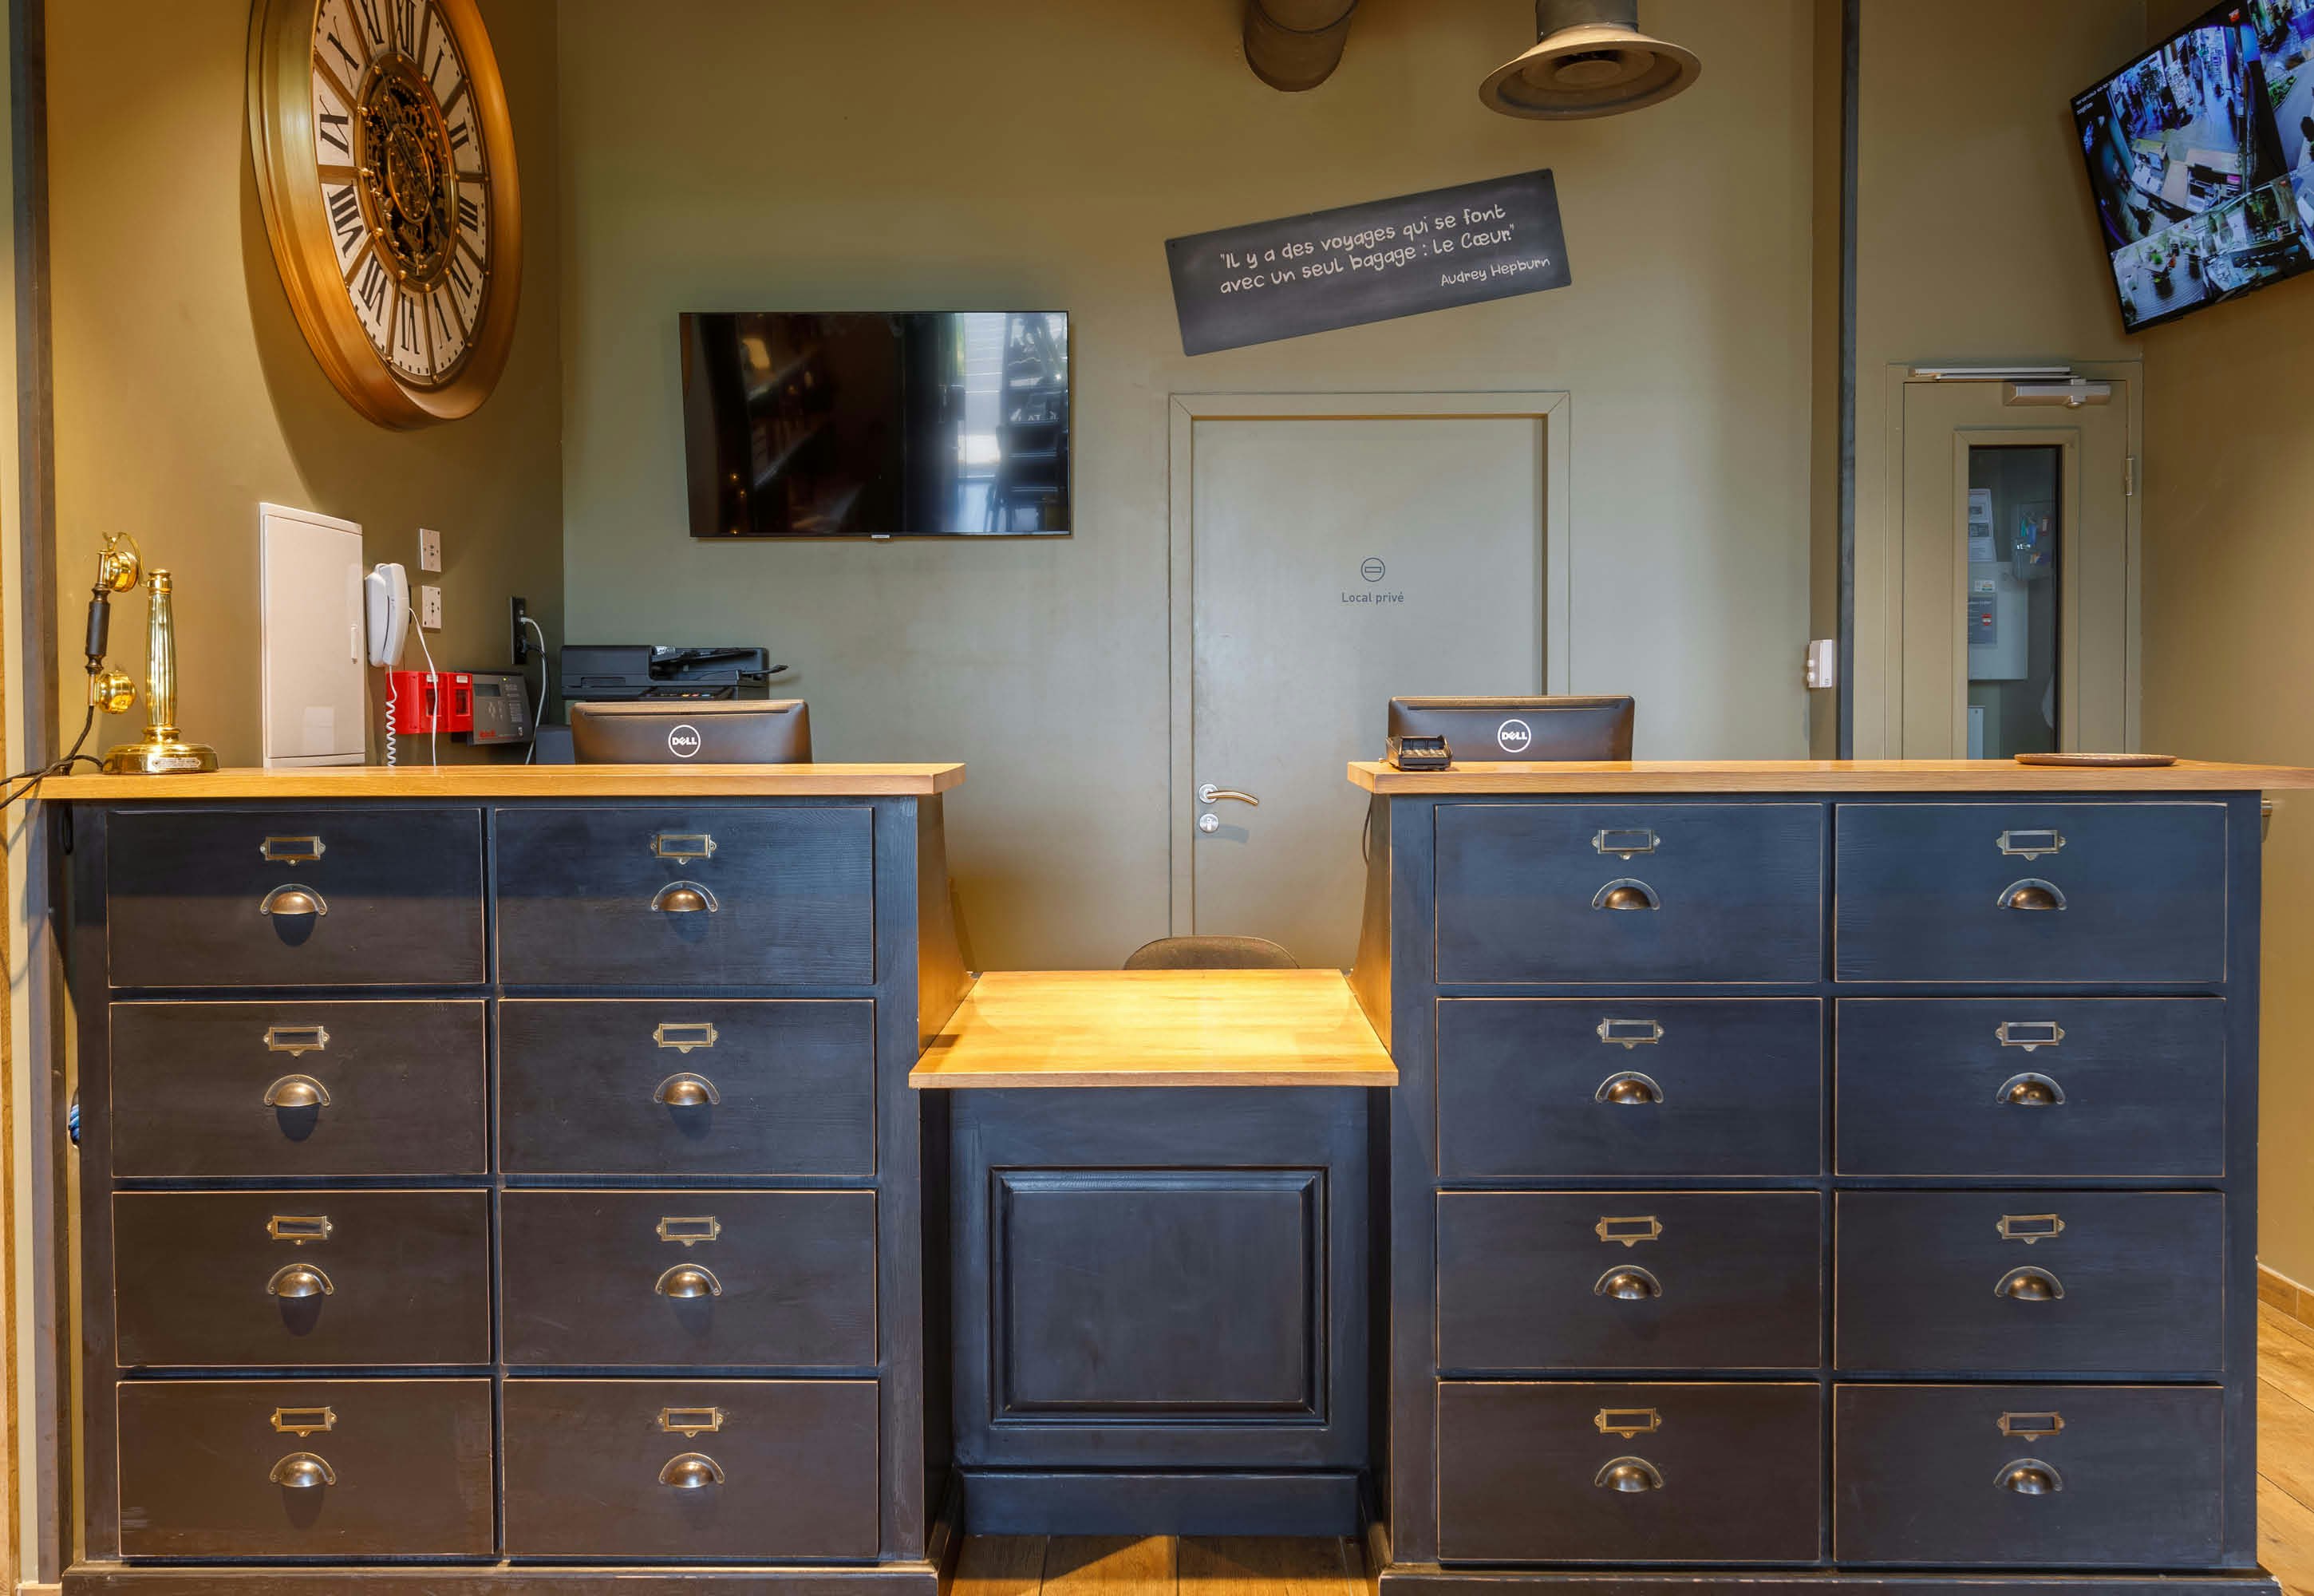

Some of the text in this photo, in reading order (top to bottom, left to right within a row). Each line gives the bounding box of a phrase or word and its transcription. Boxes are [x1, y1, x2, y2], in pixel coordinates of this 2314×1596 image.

[327, 16, 360, 89] X
[319, 95, 350, 159] IX
[326, 180, 365, 258] VIII
[1246, 253, 1258, 268] y
[1264, 249, 1275, 262] a
[1281, 242, 1314, 259] des
[1321, 226, 1396, 251] voyages
[1403, 216, 1428, 241] qui
[1435, 215, 1456, 230] se
[1463, 204, 1506, 225] font
[358, 248, 389, 326] VII
[1220, 275, 1265, 293] avec
[1270, 271, 1296, 284] un
[1301, 258, 1344, 279] seul
[1349, 246, 1416, 271] bagage
[1441, 258, 1550, 287] Audrey Hepburn
[401, 292, 420, 354] VI
[1341, 591, 1404, 605] Local privé
[672, 737, 697, 745] DELL
[1501, 731, 1528, 741] DELL
